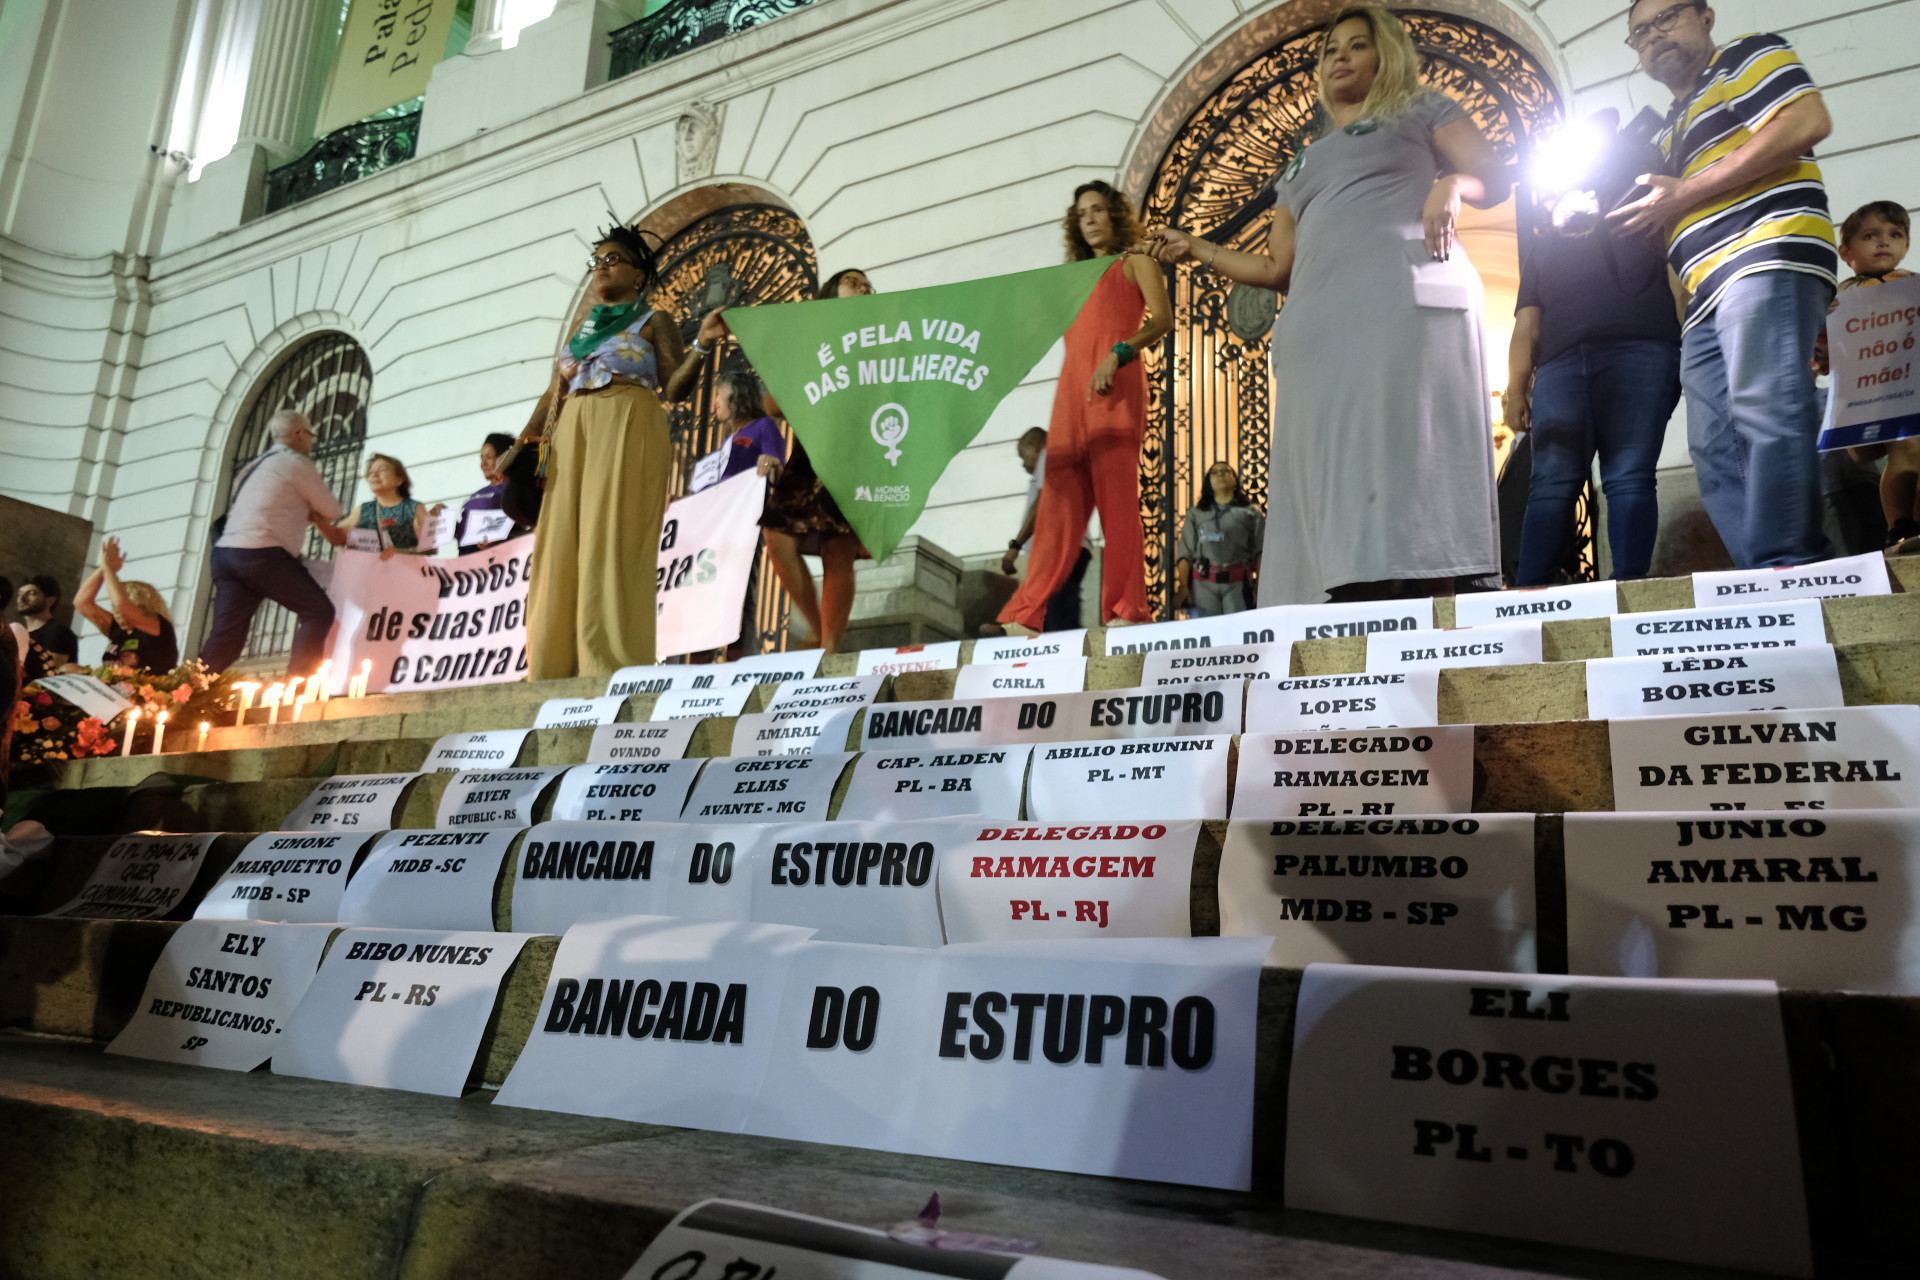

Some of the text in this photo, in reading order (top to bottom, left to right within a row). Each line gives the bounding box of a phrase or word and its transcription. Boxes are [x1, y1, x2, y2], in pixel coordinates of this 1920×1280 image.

[389, 0, 433, 76] Ped
[817, 319, 980, 368] É PELA VIDA
[1859, 332, 1915, 360] não é
[804, 354, 989, 405] DAS MULHERES
[1857, 362, 1910, 389] mãe!
[1716, 575, 1861, 595] DEL. PAULO
[1496, 600, 1571, 617] MARIO
[366, 606, 403, 641] de
[408, 610, 485, 640] suas
[1636, 614, 1795, 634] CEZINHA DE
[994, 645, 1060, 660] NIKOLAS
[1171, 654, 1259, 668] EDUARDO
[1401, 643, 1503, 661] BIA KICIS
[390, 647, 513, 684] e contra
[1662, 657, 1748, 673] LÊDA
[792, 681, 862, 696] RENILCE
[993, 679, 1044, 688] CARLA
[1278, 674, 1406, 691] CRISTIANE
[1642, 679, 1775, 702] BORGES
[563, 705, 593, 715] FRED
[681, 698, 724, 708] FILIPE
[772, 693, 868, 711] NICODEMOS
[1300, 698, 1376, 715] LOPES
[772, 711, 819, 722] JUNIO
[868, 691, 1223, 739] BANCADA DO ESTUPRO
[615, 729, 668, 738] DR. LUIZ
[757, 726, 820, 740] AMARAL
[1684, 722, 1836, 745] GILVAN
[610, 747, 660, 757] OVANDO
[1045, 740, 1214, 760] ABILIO BRUNINI
[1274, 736, 1432, 754] DELEGADO
[437, 750, 504, 759] FREDERICO
[877, 752, 1006, 769] CAP. ALDEN
[595, 764, 670, 774] PASTOR
[735, 759, 813, 772] GREYCE
[1087, 769, 1114, 782] PL
[1132, 766, 1165, 780] MT
[1639, 760, 1901, 786] DA FEDERAL
[460, 772, 545, 784] FRANCIANE
[734, 779, 789, 794] ELIAS
[895, 780, 923, 792] PL
[941, 778, 971, 791] BA
[1274, 770, 1429, 786] RAMAGEM
[316, 793, 377, 805] DE MELO
[465, 789, 511, 804] BAYER
[586, 784, 656, 798] EURICO
[449, 809, 516, 825] REPUBLIC RS
[586, 808, 643, 820] PL PE
[700, 803, 764, 815] AVANTE
[777, 801, 806, 813] MG
[1298, 803, 1336, 816] PL
[311, 813, 359, 824] PP ES
[976, 823, 1168, 842] DELEGADO
[1269, 820, 1481, 838] DELEGADO
[1677, 819, 1826, 846] JUNIO
[269, 837, 341, 849] SIMONE
[400, 833, 489, 846] PEZENTI
[230, 858, 342, 877] MARQUETTO
[388, 859, 433, 872] MDB
[522, 840, 934, 886] BANCADA DO ESTUPRO
[971, 856, 1156, 877] RAMAGEM
[1274, 855, 1468, 879] PALUMBO
[1647, 857, 1878, 883] AMARAL
[232, 886, 310, 903] MDB SP
[1010, 900, 1049, 920] PL
[1075, 901, 1109, 928] RJ
[1280, 899, 1372, 922] MDB
[1407, 902, 1458, 925] SP
[1667, 905, 1733, 929] PL
[1776, 905, 1867, 932] MG
[221, 933, 266, 956] ELY
[345, 942, 493, 965] BIBO NUNES
[186, 967, 272, 999] SANTOS
[354, 981, 387, 1002] PL
[404, 984, 440, 1006] RS
[1467, 986, 1572, 1023] ELI
[150, 999, 275, 1034] REPUBLICANOS
[544, 976, 1214, 1070] BANCADA DO ESTUPRO
[181, 1036, 208, 1050] SP
[1391, 1045, 1658, 1101] BORGES
[1413, 1119, 1491, 1162] PL
[1544, 1133, 1635, 1178] TO
